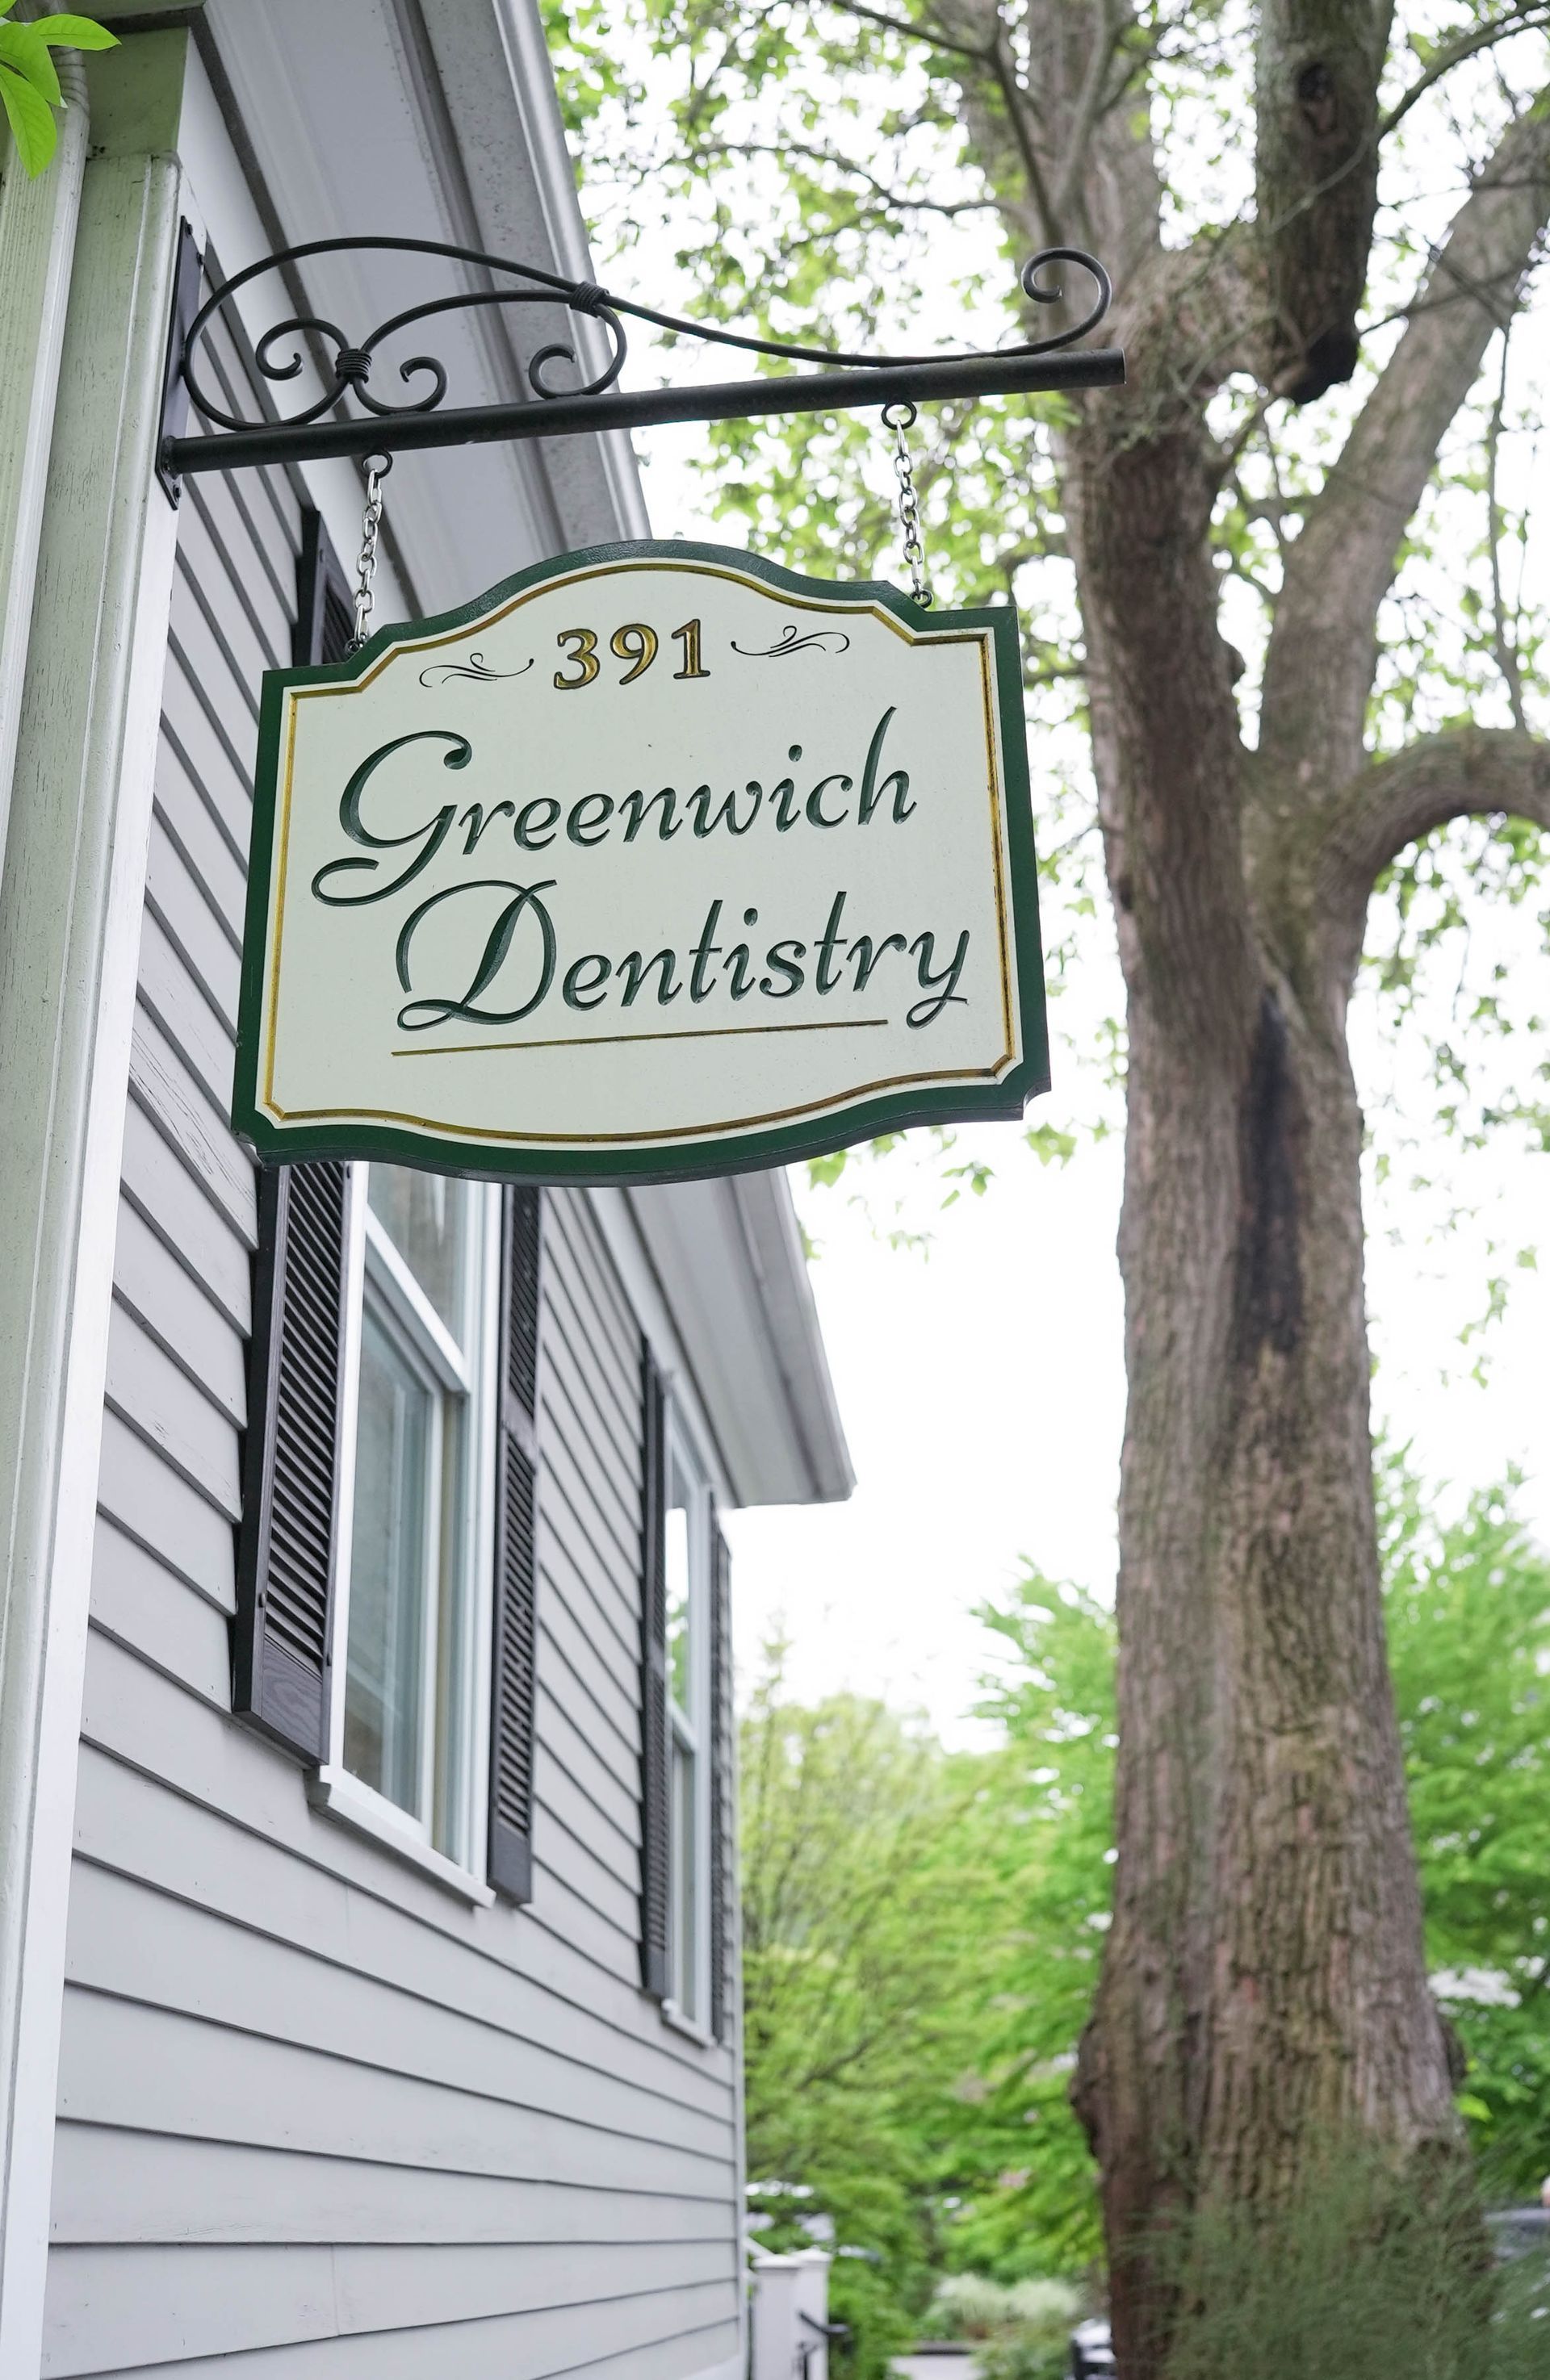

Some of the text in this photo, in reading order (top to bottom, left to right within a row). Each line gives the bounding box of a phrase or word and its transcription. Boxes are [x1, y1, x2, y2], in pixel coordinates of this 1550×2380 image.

[552, 618, 710, 690] 391
[312, 706, 917, 907] Greenwich
[396, 880, 969, 1031] Dentistry
